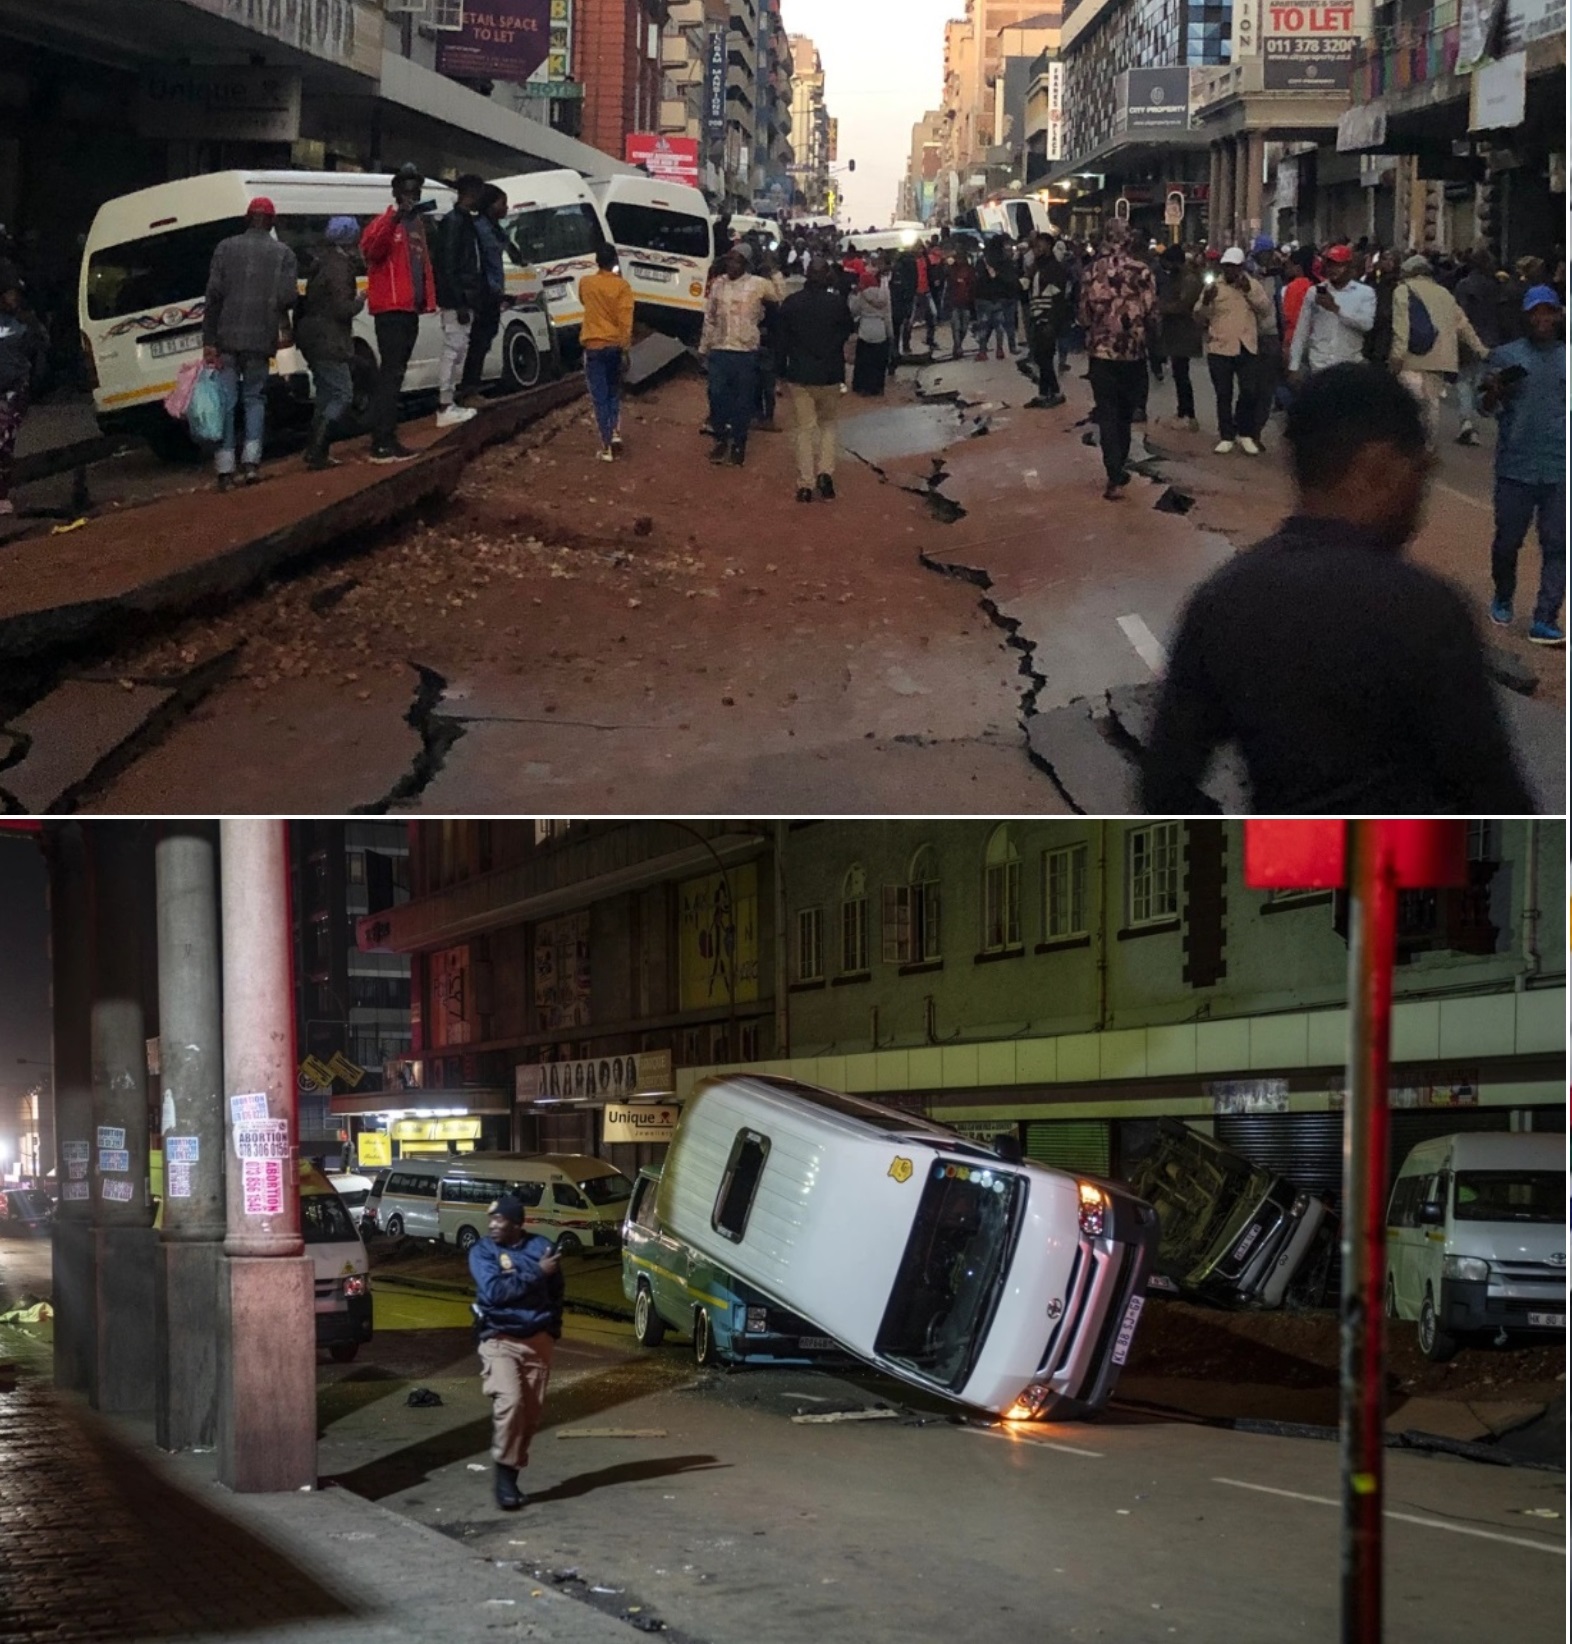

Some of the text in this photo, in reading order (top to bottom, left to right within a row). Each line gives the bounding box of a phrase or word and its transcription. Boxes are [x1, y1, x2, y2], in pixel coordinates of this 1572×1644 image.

[459, 12, 538, 31] ETAIL SPACE
[1270, 7, 1354, 31] TO LET
[473, 27, 515, 43] TO LET
[1267, 39, 1290, 53] 011
[1295, 39, 1319, 53] 378
[1146, 105, 1186, 113] PROPERTY
[608, 1110, 656, 1127] Unique
[239, 1132, 288, 1143] ABORTION
[265, 1161, 280, 1212] ABORTION
[1113, 1349, 1125, 1364] KL
[1123, 1317, 1135, 1331] SJ
[1129, 1298, 1141, 1311] GP
